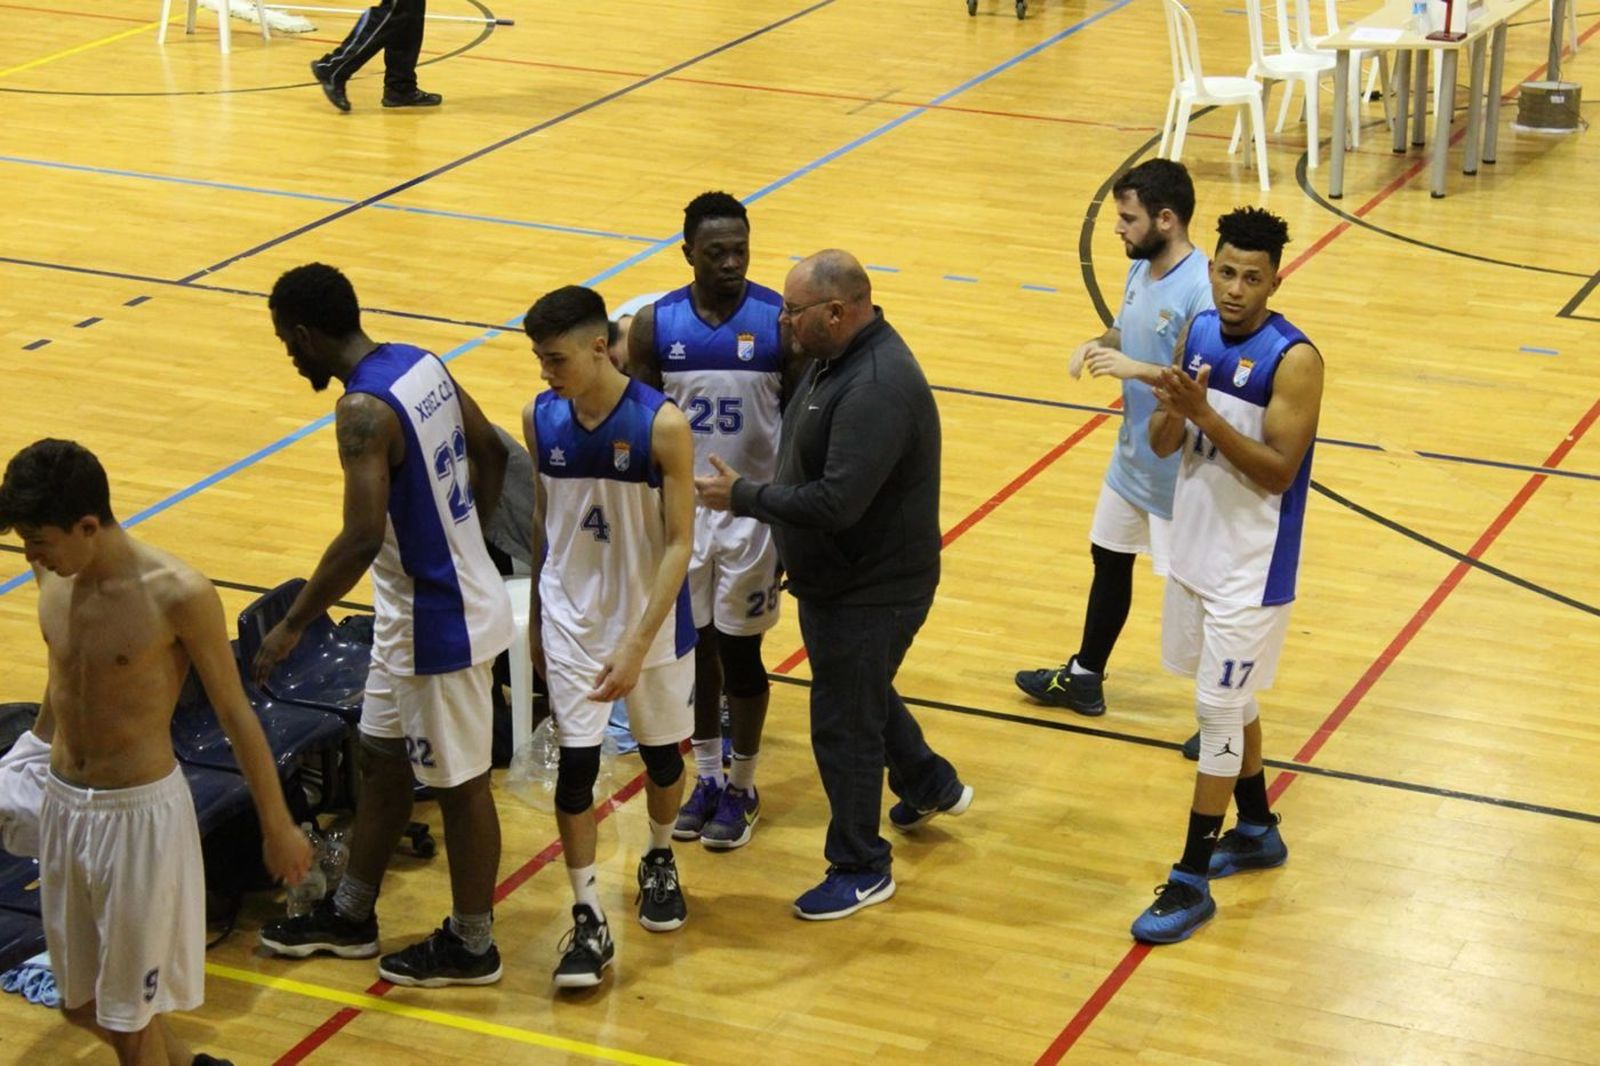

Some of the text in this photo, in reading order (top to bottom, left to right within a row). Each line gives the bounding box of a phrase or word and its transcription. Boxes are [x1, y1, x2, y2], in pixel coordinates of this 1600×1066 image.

[689, 396, 744, 435] 25
[581, 504, 611, 543] 4
[1218, 658, 1256, 690] 17
[403, 733, 437, 768] 22
[144, 966, 160, 1004] 9
